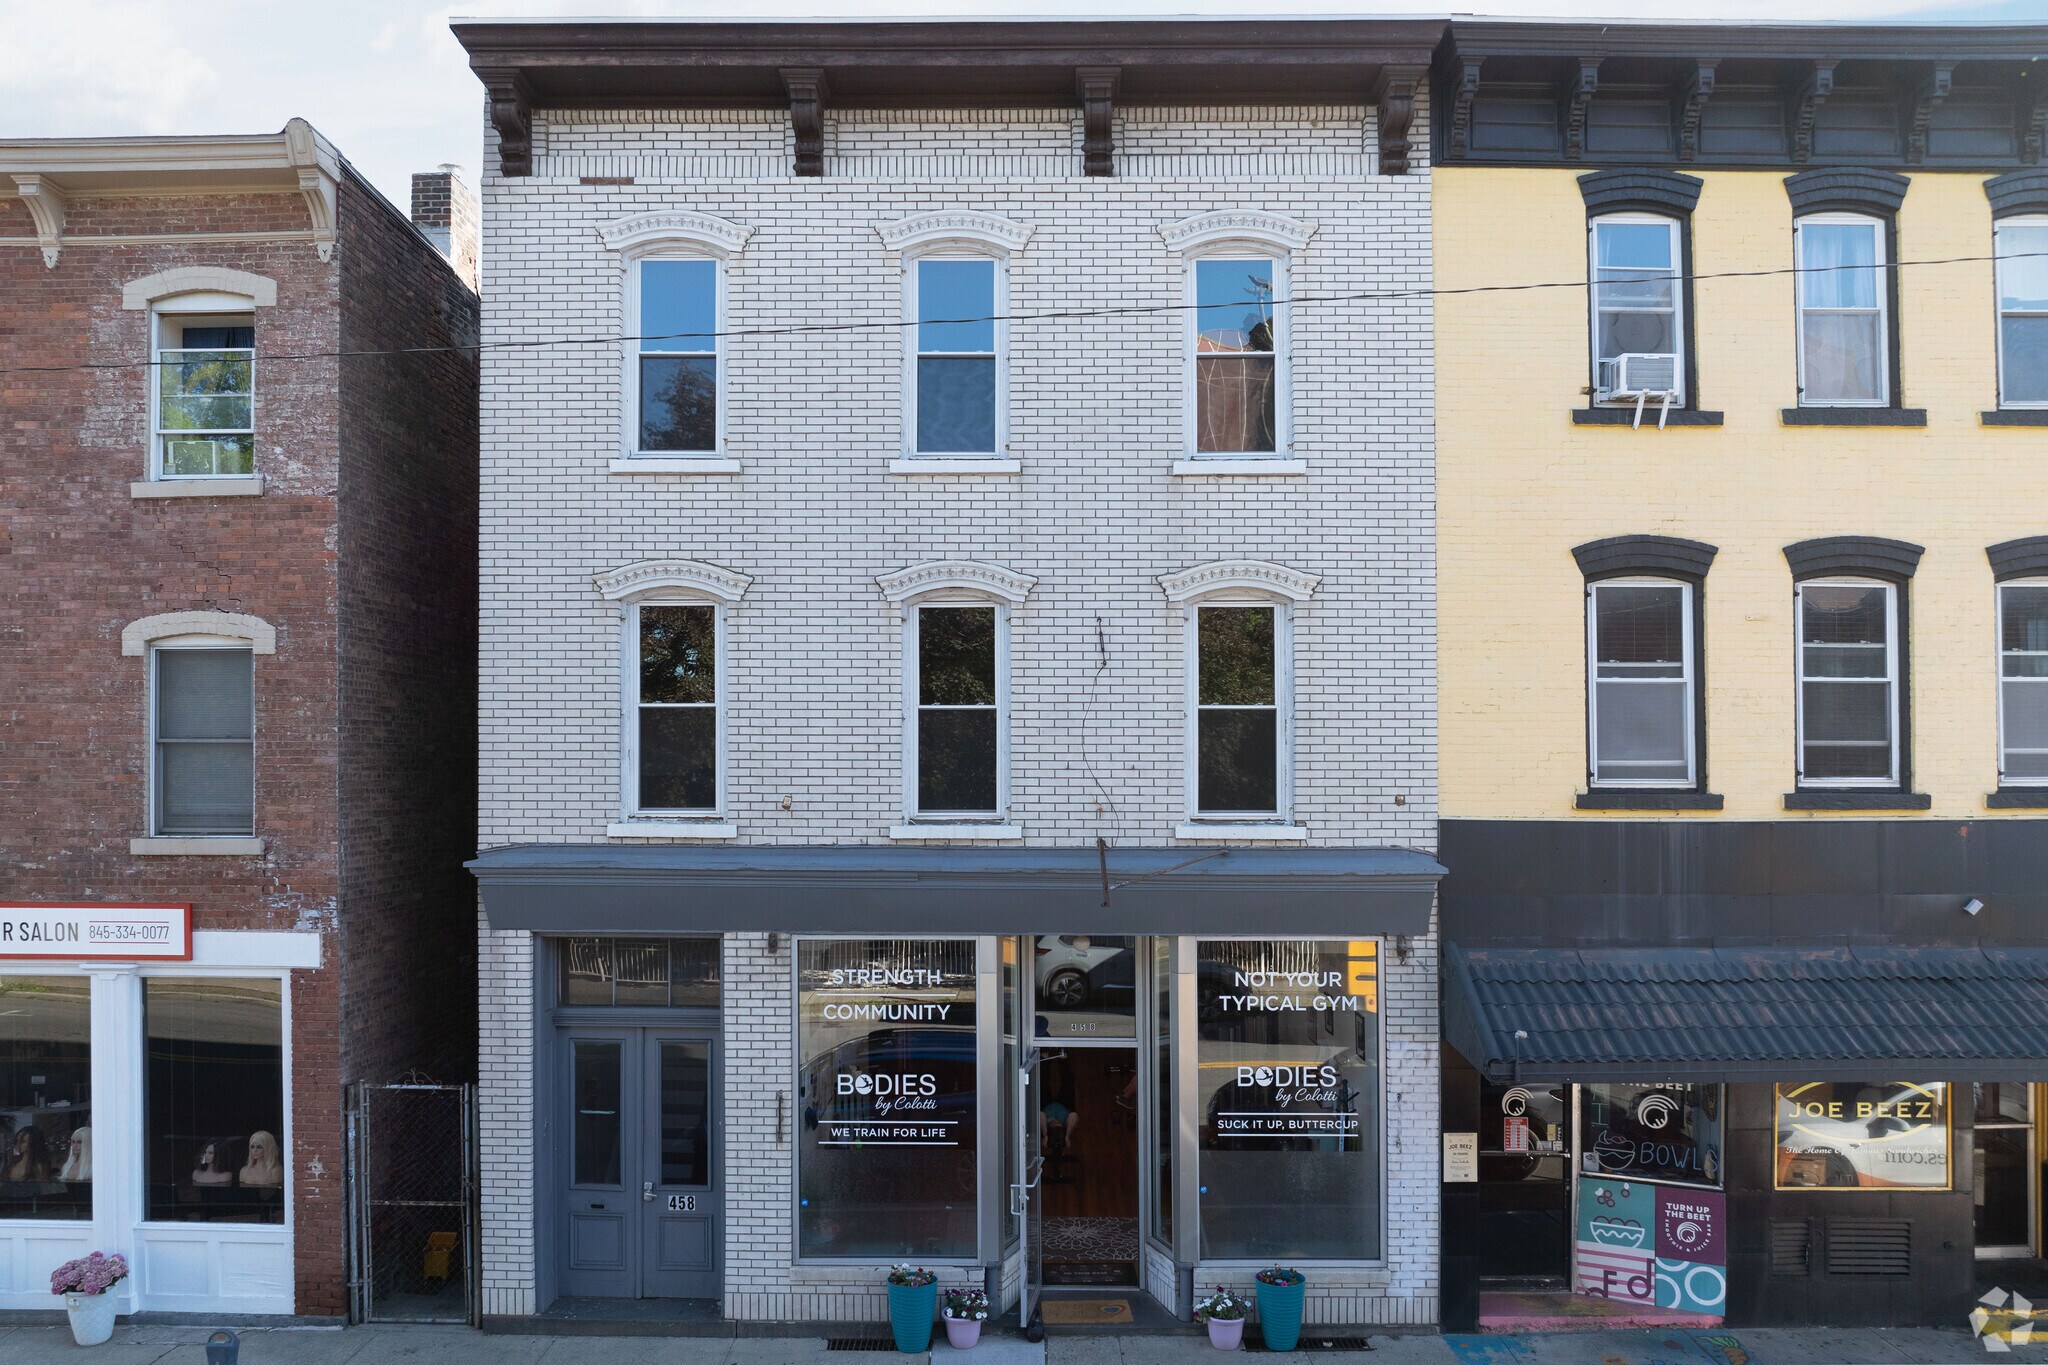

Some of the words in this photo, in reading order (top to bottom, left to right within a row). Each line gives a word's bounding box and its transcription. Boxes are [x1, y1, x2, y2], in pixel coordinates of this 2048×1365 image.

[20, 922, 79, 942] SALON
[89, 925, 169, 940] 845-334-0077
[832, 969, 941, 985] STRENGTH
[1235, 971, 1276, 987] NOT
[1286, 971, 1342, 987] YOUR
[1219, 995, 1306, 1011] TYPICAL
[1312, 995, 1357, 1011] GYM
[823, 1004, 950, 1020] COMMUNITY
[1072, 1023, 1095, 1031] 458
[1237, 1066, 1337, 1087] BODIES
[837, 1074, 936, 1096] BODIES
[1275, 1088, 1292, 1107] by
[1294, 1088, 1337, 1102] Colotti
[875, 1096, 892, 1116] by
[894, 1096, 937, 1110] Colotti
[1789, 1102, 1843, 1118] JOE
[1856, 1102, 1932, 1118] BEEZ
[831, 1128, 850, 1137] WE
[854, 1128, 889, 1137] TRAIN
[893, 1128, 917, 1138] FOR
[921, 1128, 946, 1138] LIFE
[1218, 1120, 1249, 1129] SUCK
[1253, 1120, 1263, 1129] IT
[1267, 1120, 1285, 1131] UP,
[1289, 1120, 1358, 1130] BUTTERCUP
[1640, 1142, 1718, 1172] BOWLS
[1785, 1146, 1802, 1154] The
[1805, 1146, 1832, 1154] Home
[669, 1196, 695, 1210] 458
[1666, 1202, 1693, 1212] TURN
[1665, 1209, 1684, 1219] THE
[1687, 1213, 1711, 1221] BEET
